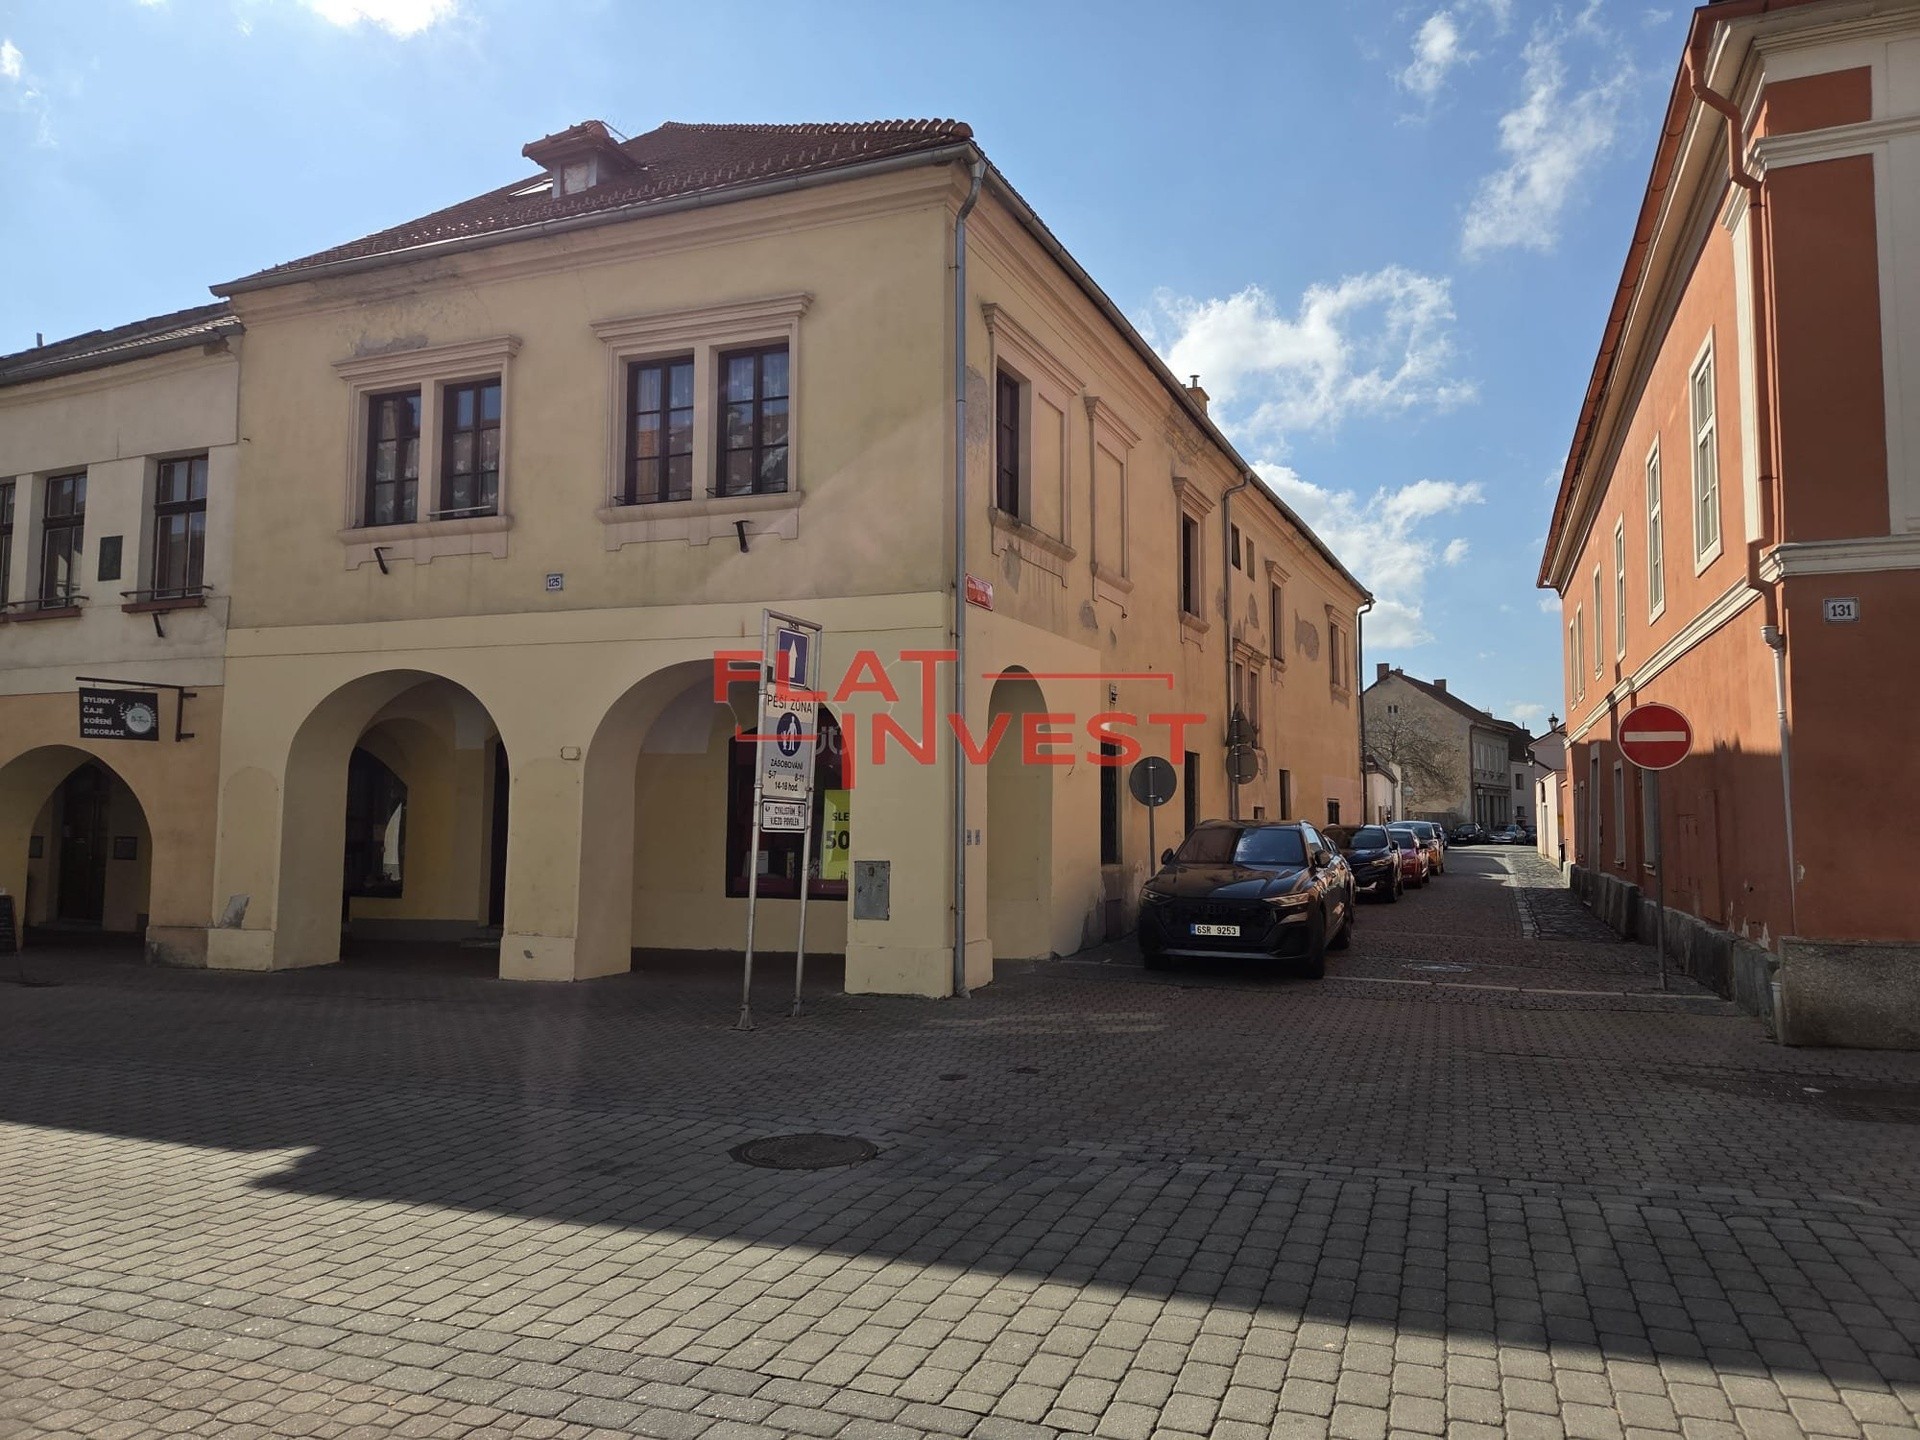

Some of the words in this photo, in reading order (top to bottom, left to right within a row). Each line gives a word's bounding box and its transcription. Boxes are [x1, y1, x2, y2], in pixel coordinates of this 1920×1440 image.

[548, 577, 560, 588] 125
[1831, 604, 1852, 617] 131
[83, 696, 116, 705] BYLINKY
[83, 705, 104, 714] ČAJE
[83, 717, 112, 725] KOŘENÍ
[83, 728, 125, 736] DEKORACE
[1197, 925, 1211, 934] 6SR
[1217, 926, 1236, 935] 9253
